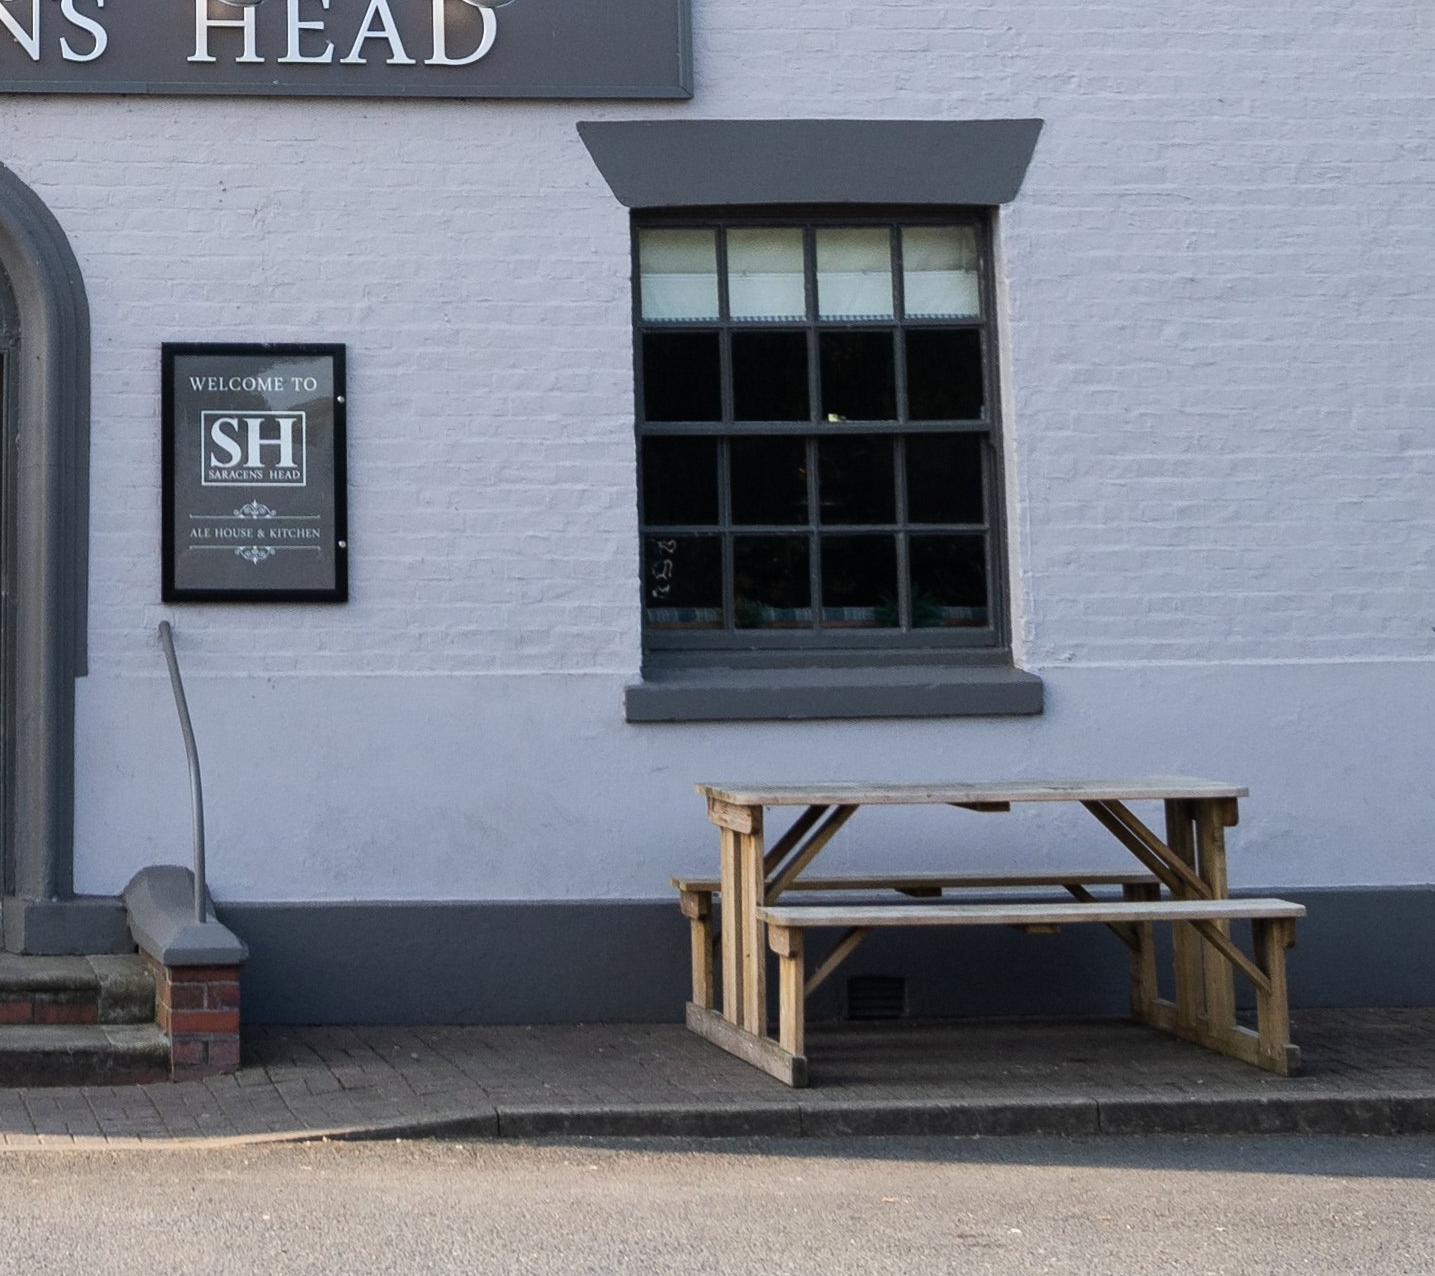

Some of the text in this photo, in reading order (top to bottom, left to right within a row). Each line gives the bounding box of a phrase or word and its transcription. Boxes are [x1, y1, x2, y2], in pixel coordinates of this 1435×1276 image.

[189, 376, 318, 391] WELCOME TO
[210, 417, 298, 468] SH
[269, 470, 301, 479] HEAD
[189, 527, 321, 538] ALE HOUSE & KITCHEN
